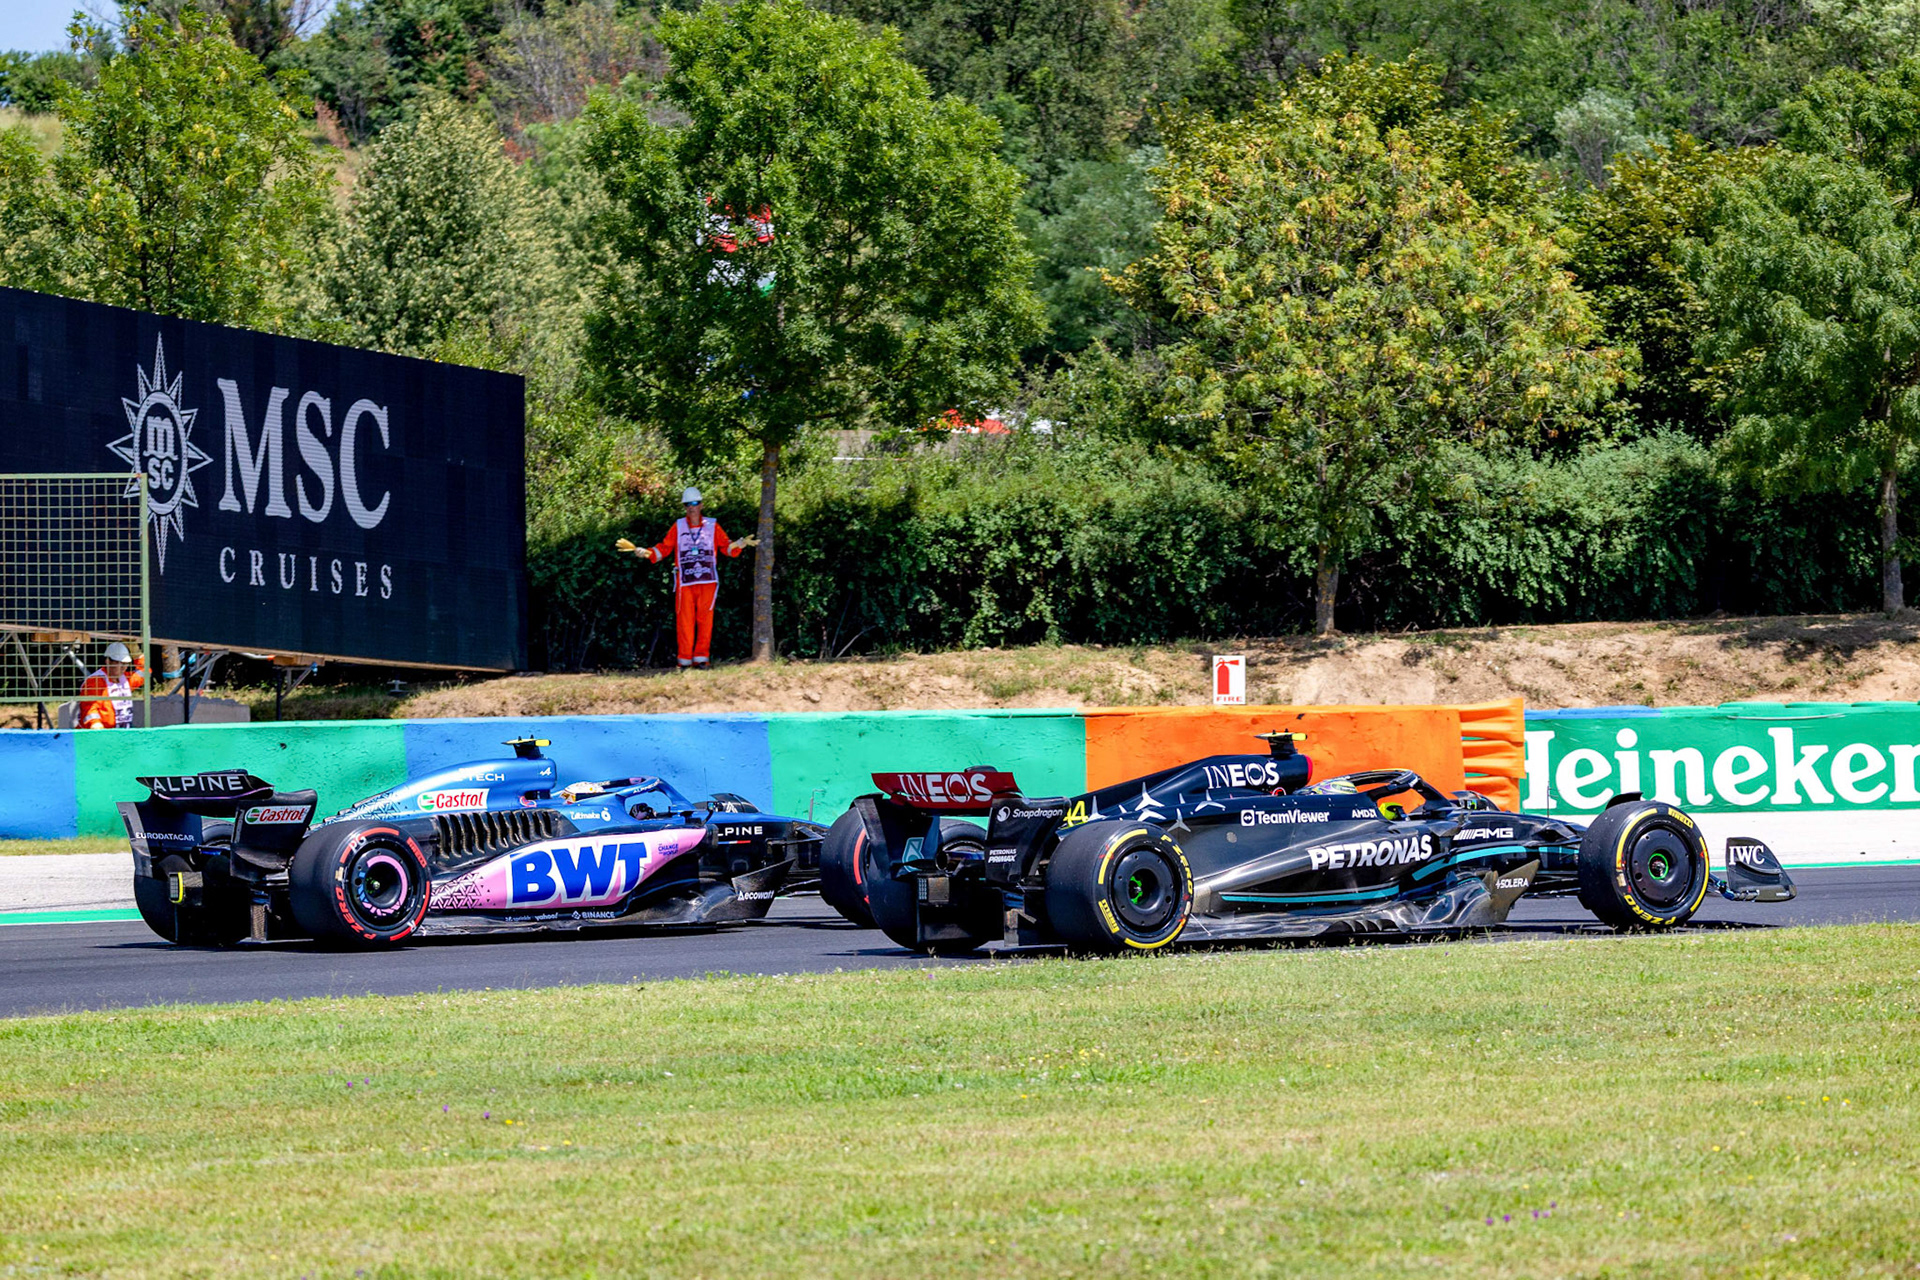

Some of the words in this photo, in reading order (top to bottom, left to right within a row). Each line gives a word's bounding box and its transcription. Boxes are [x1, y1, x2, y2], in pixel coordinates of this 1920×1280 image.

[217, 377, 391, 529] MSC
[219, 546, 393, 599] CRUISES
[153, 775, 244, 792] ALPINE
[1203, 762, 1280, 789] INEOS
[897, 773, 993, 803] INEOS
[436, 791, 484, 809] Castrol
[259, 807, 306, 822] Castrol
[1012, 808, 1063, 819] Snapdragon
[1255, 810, 1330, 824] TeamViewer
[135, 832, 195, 842] EURODATACAR
[1473, 828, 1514, 839] AMG
[1307, 834, 1433, 870] PETRONAS
[1729, 845, 1765, 865] IWC
[510, 842, 648, 904] BWT
[1501, 878, 1529, 889] SOLERA
[744, 890, 775, 900] ecowatt
[534, 912, 559, 921] yahoo!
[581, 911, 616, 919] BINANCE
